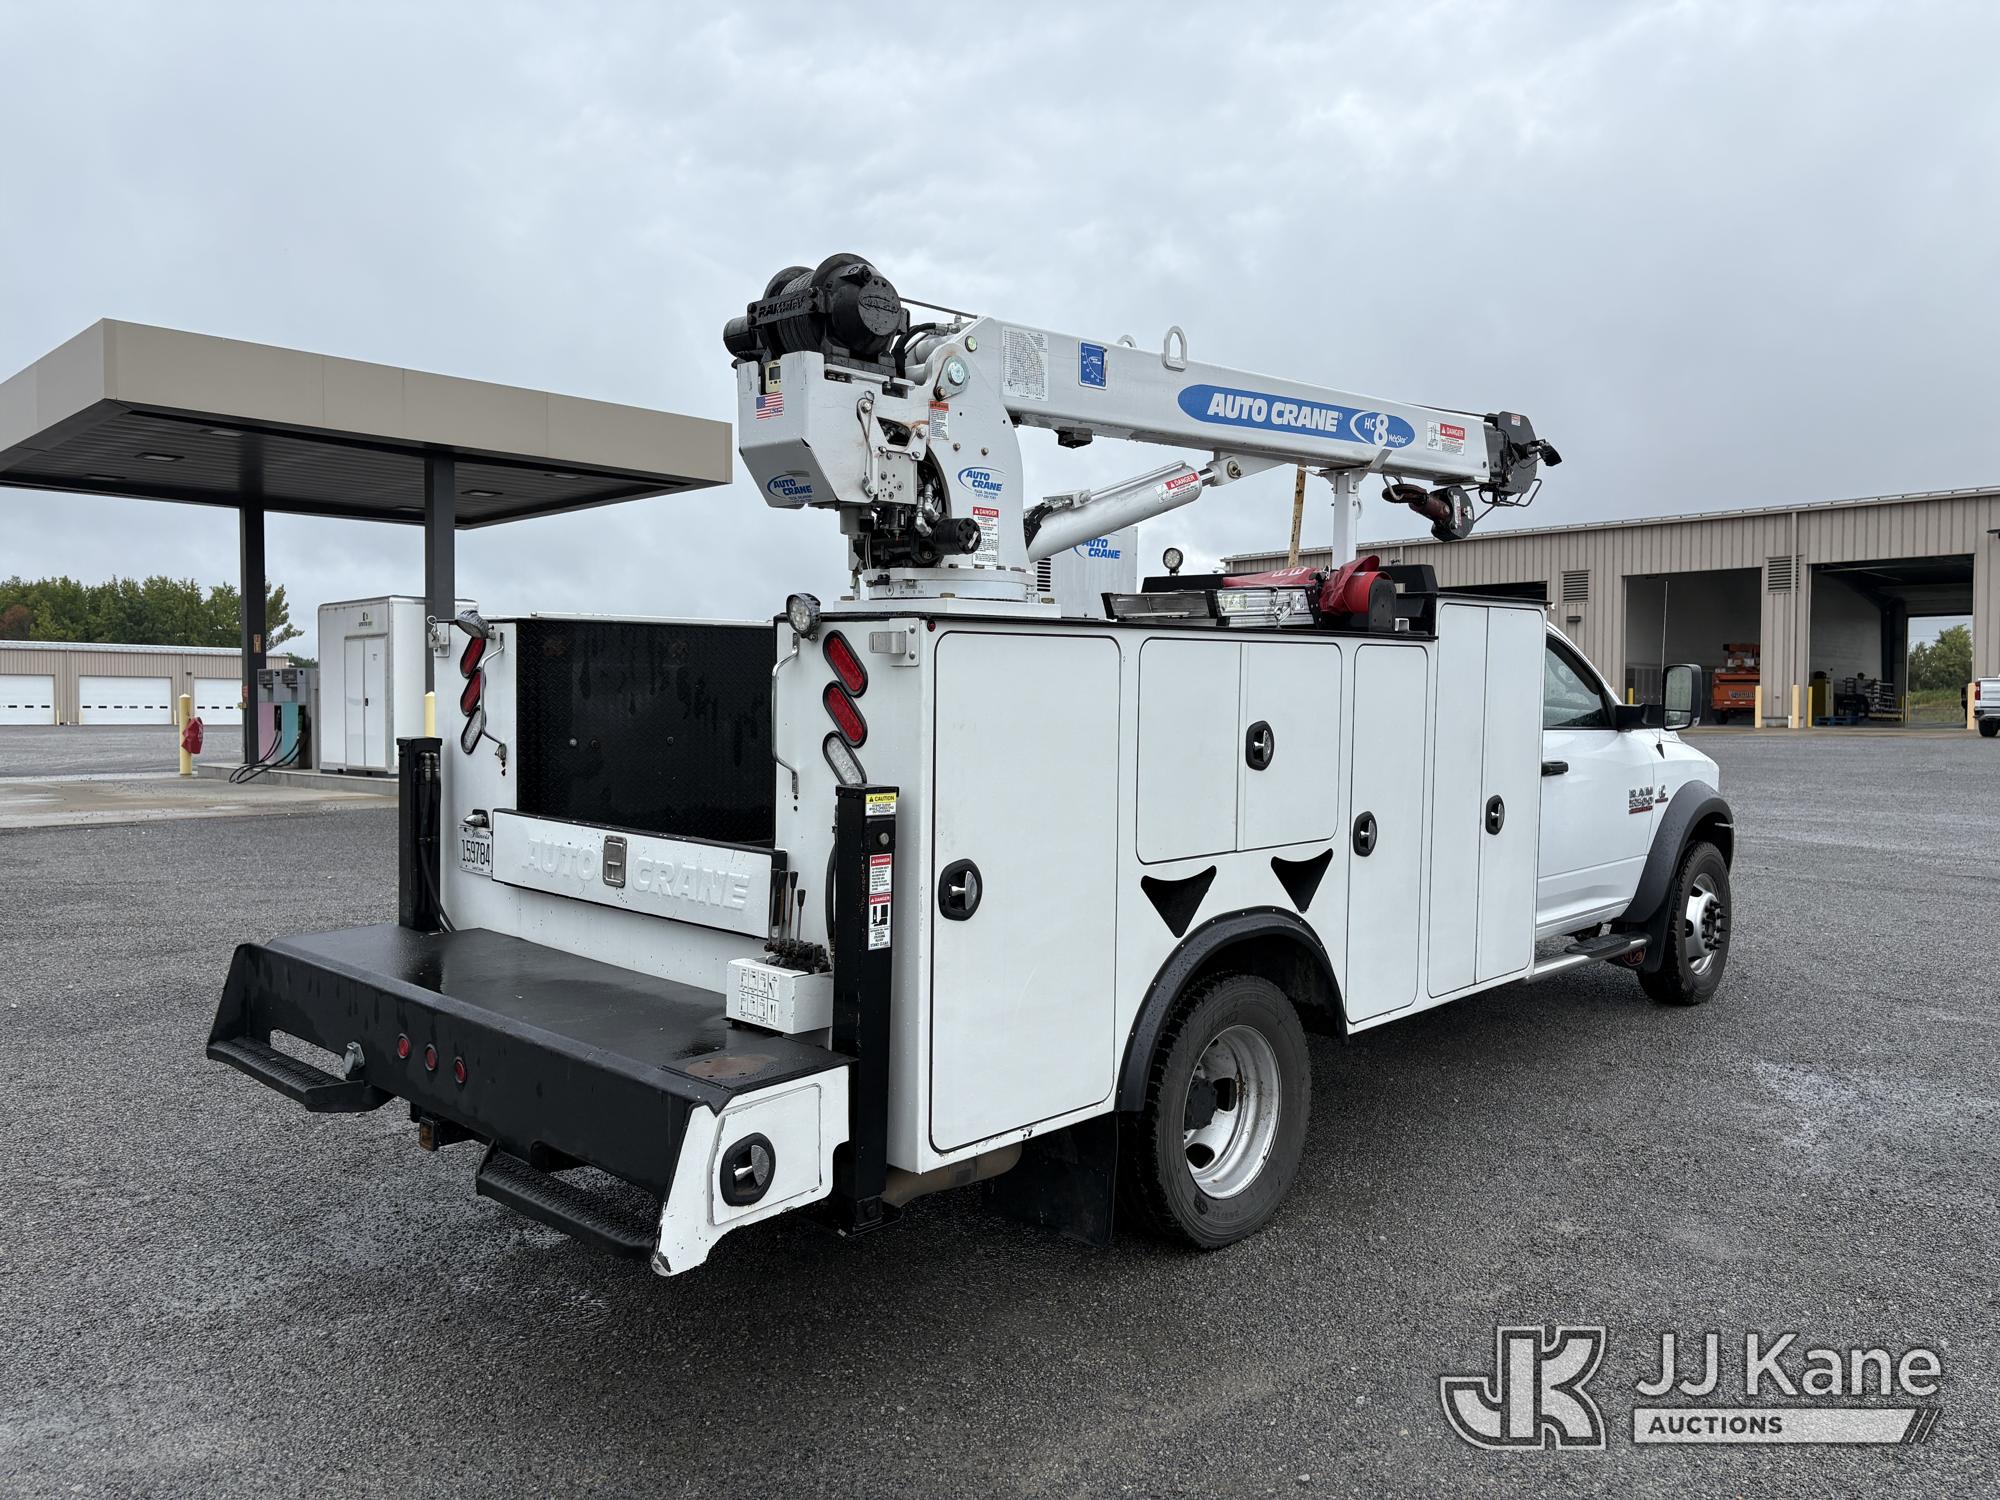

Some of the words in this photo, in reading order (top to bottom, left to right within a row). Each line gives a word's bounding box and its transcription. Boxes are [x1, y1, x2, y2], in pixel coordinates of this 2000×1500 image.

[1207, 392, 1268, 422] AUTO
[1446, 426, 1464, 437] DANGER
[966, 470, 990, 481] AUTO
[1173, 474, 1196, 486] DANGER
[773, 478, 797, 489] AUTO
[972, 480, 1003, 492] CRANE
[782, 485, 813, 496] CRANE
[979, 509, 998, 517] DANGER
[1088, 547, 1121, 559] CRANE
[1629, 786, 1654, 799] RAM
[461, 839, 491, 867] 159784
[521, 838, 599, 882] AUTO
[631, 856, 750, 910] CRANE
[874, 895, 890, 903] DANGER
